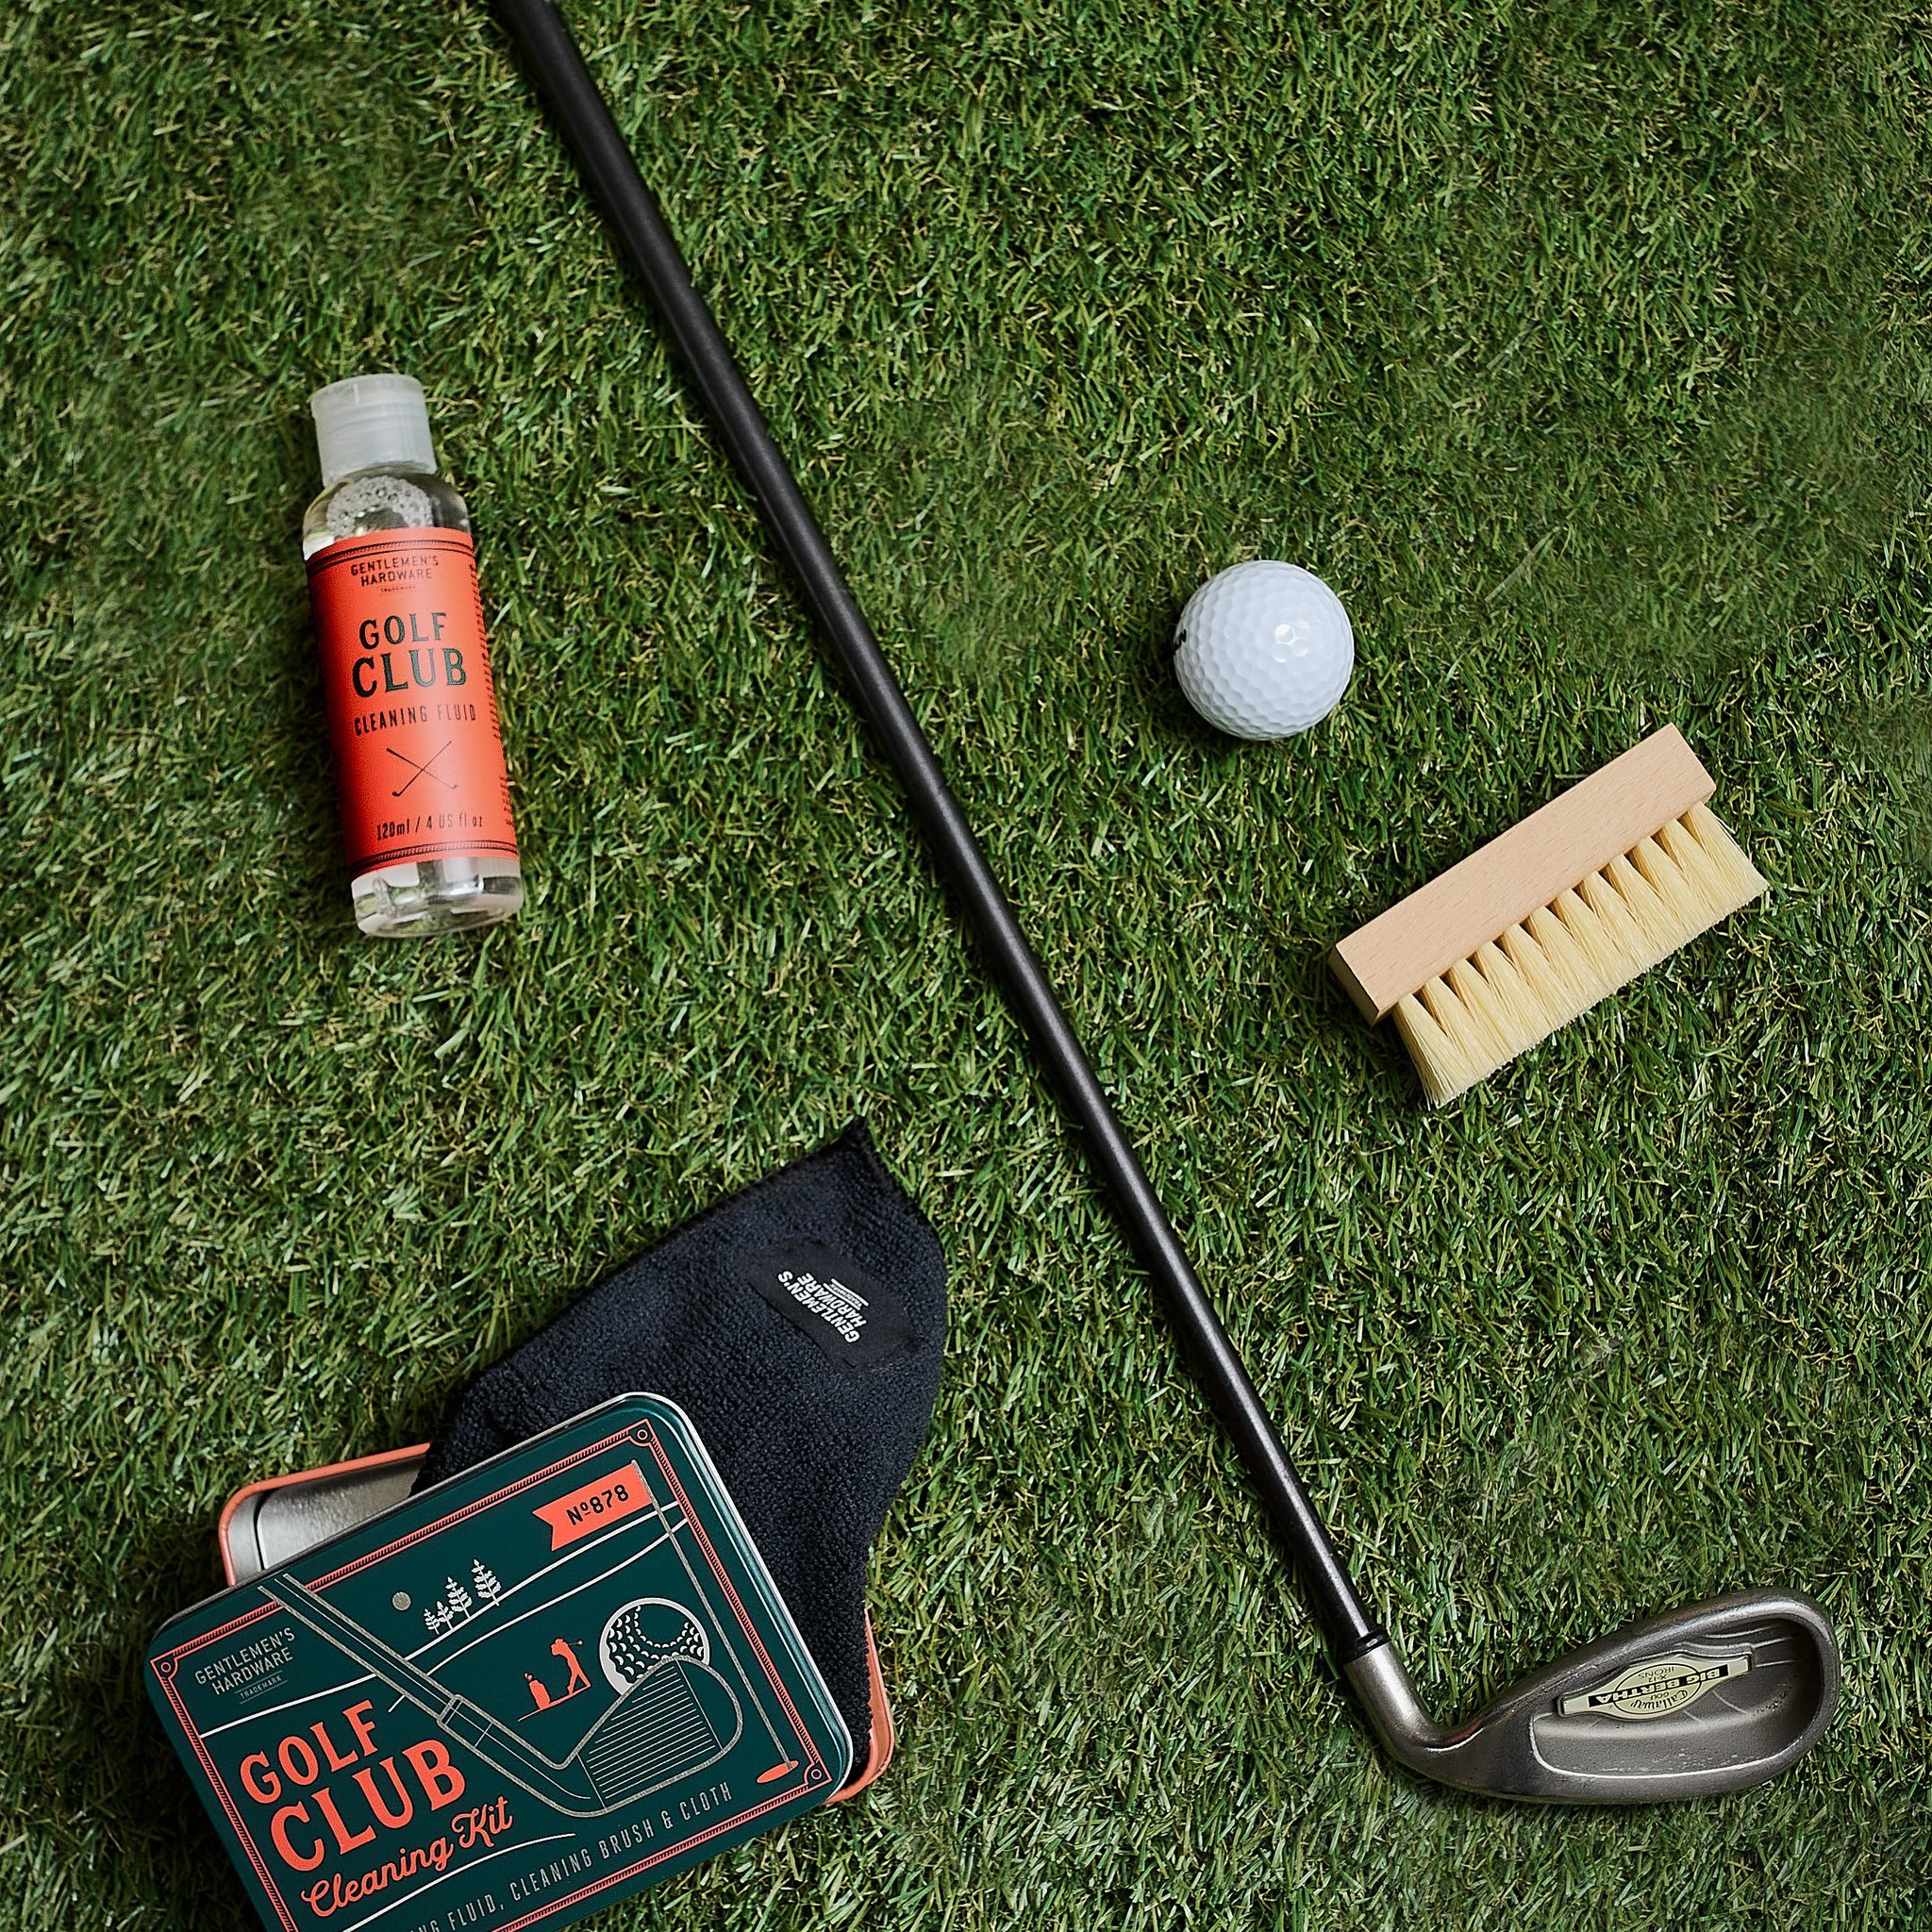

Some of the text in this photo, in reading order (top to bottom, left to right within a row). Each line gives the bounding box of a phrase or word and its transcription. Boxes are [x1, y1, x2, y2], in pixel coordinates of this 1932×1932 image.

[350, 555, 440, 576] GENTLEMEN'S
[360, 568, 433, 587] HARDWARE
[358, 612, 447, 650] GOLF
[352, 647, 467, 698] CLUB
[354, 704, 476, 737] CLEANING FLUID
[376, 818, 410, 841] 120ml
[425, 815, 433, 828] 4
[439, 813, 453, 828] US
[458, 811, 468, 827] fl
[472, 815, 483, 827] oz
[777, 1270, 860, 1343] GENTLEMEN'S
[796, 1273, 867, 1328] HARDWARE
[194, 1627, 295, 1685] GENTLEMEN'S
[211, 1646, 293, 1695] HARDWARE
[1638, 1666, 1674, 1680] IRONS
[240, 1674, 282, 1699] TRADEMARK
[1595, 1668, 1721, 1704] BIG BERTHA
[1630, 1690, 1689, 1710] Callaway
[1650, 1691, 1670, 1701] GOLF
[240, 1699, 378, 1805] GOLF
[271, 1739, 467, 1872] CLUB
[300, 1795, 513, 1918] Cleaning Kit
[447, 1781, 732, 1931] FLUID, CLEANING BRUSH & CLOTH
